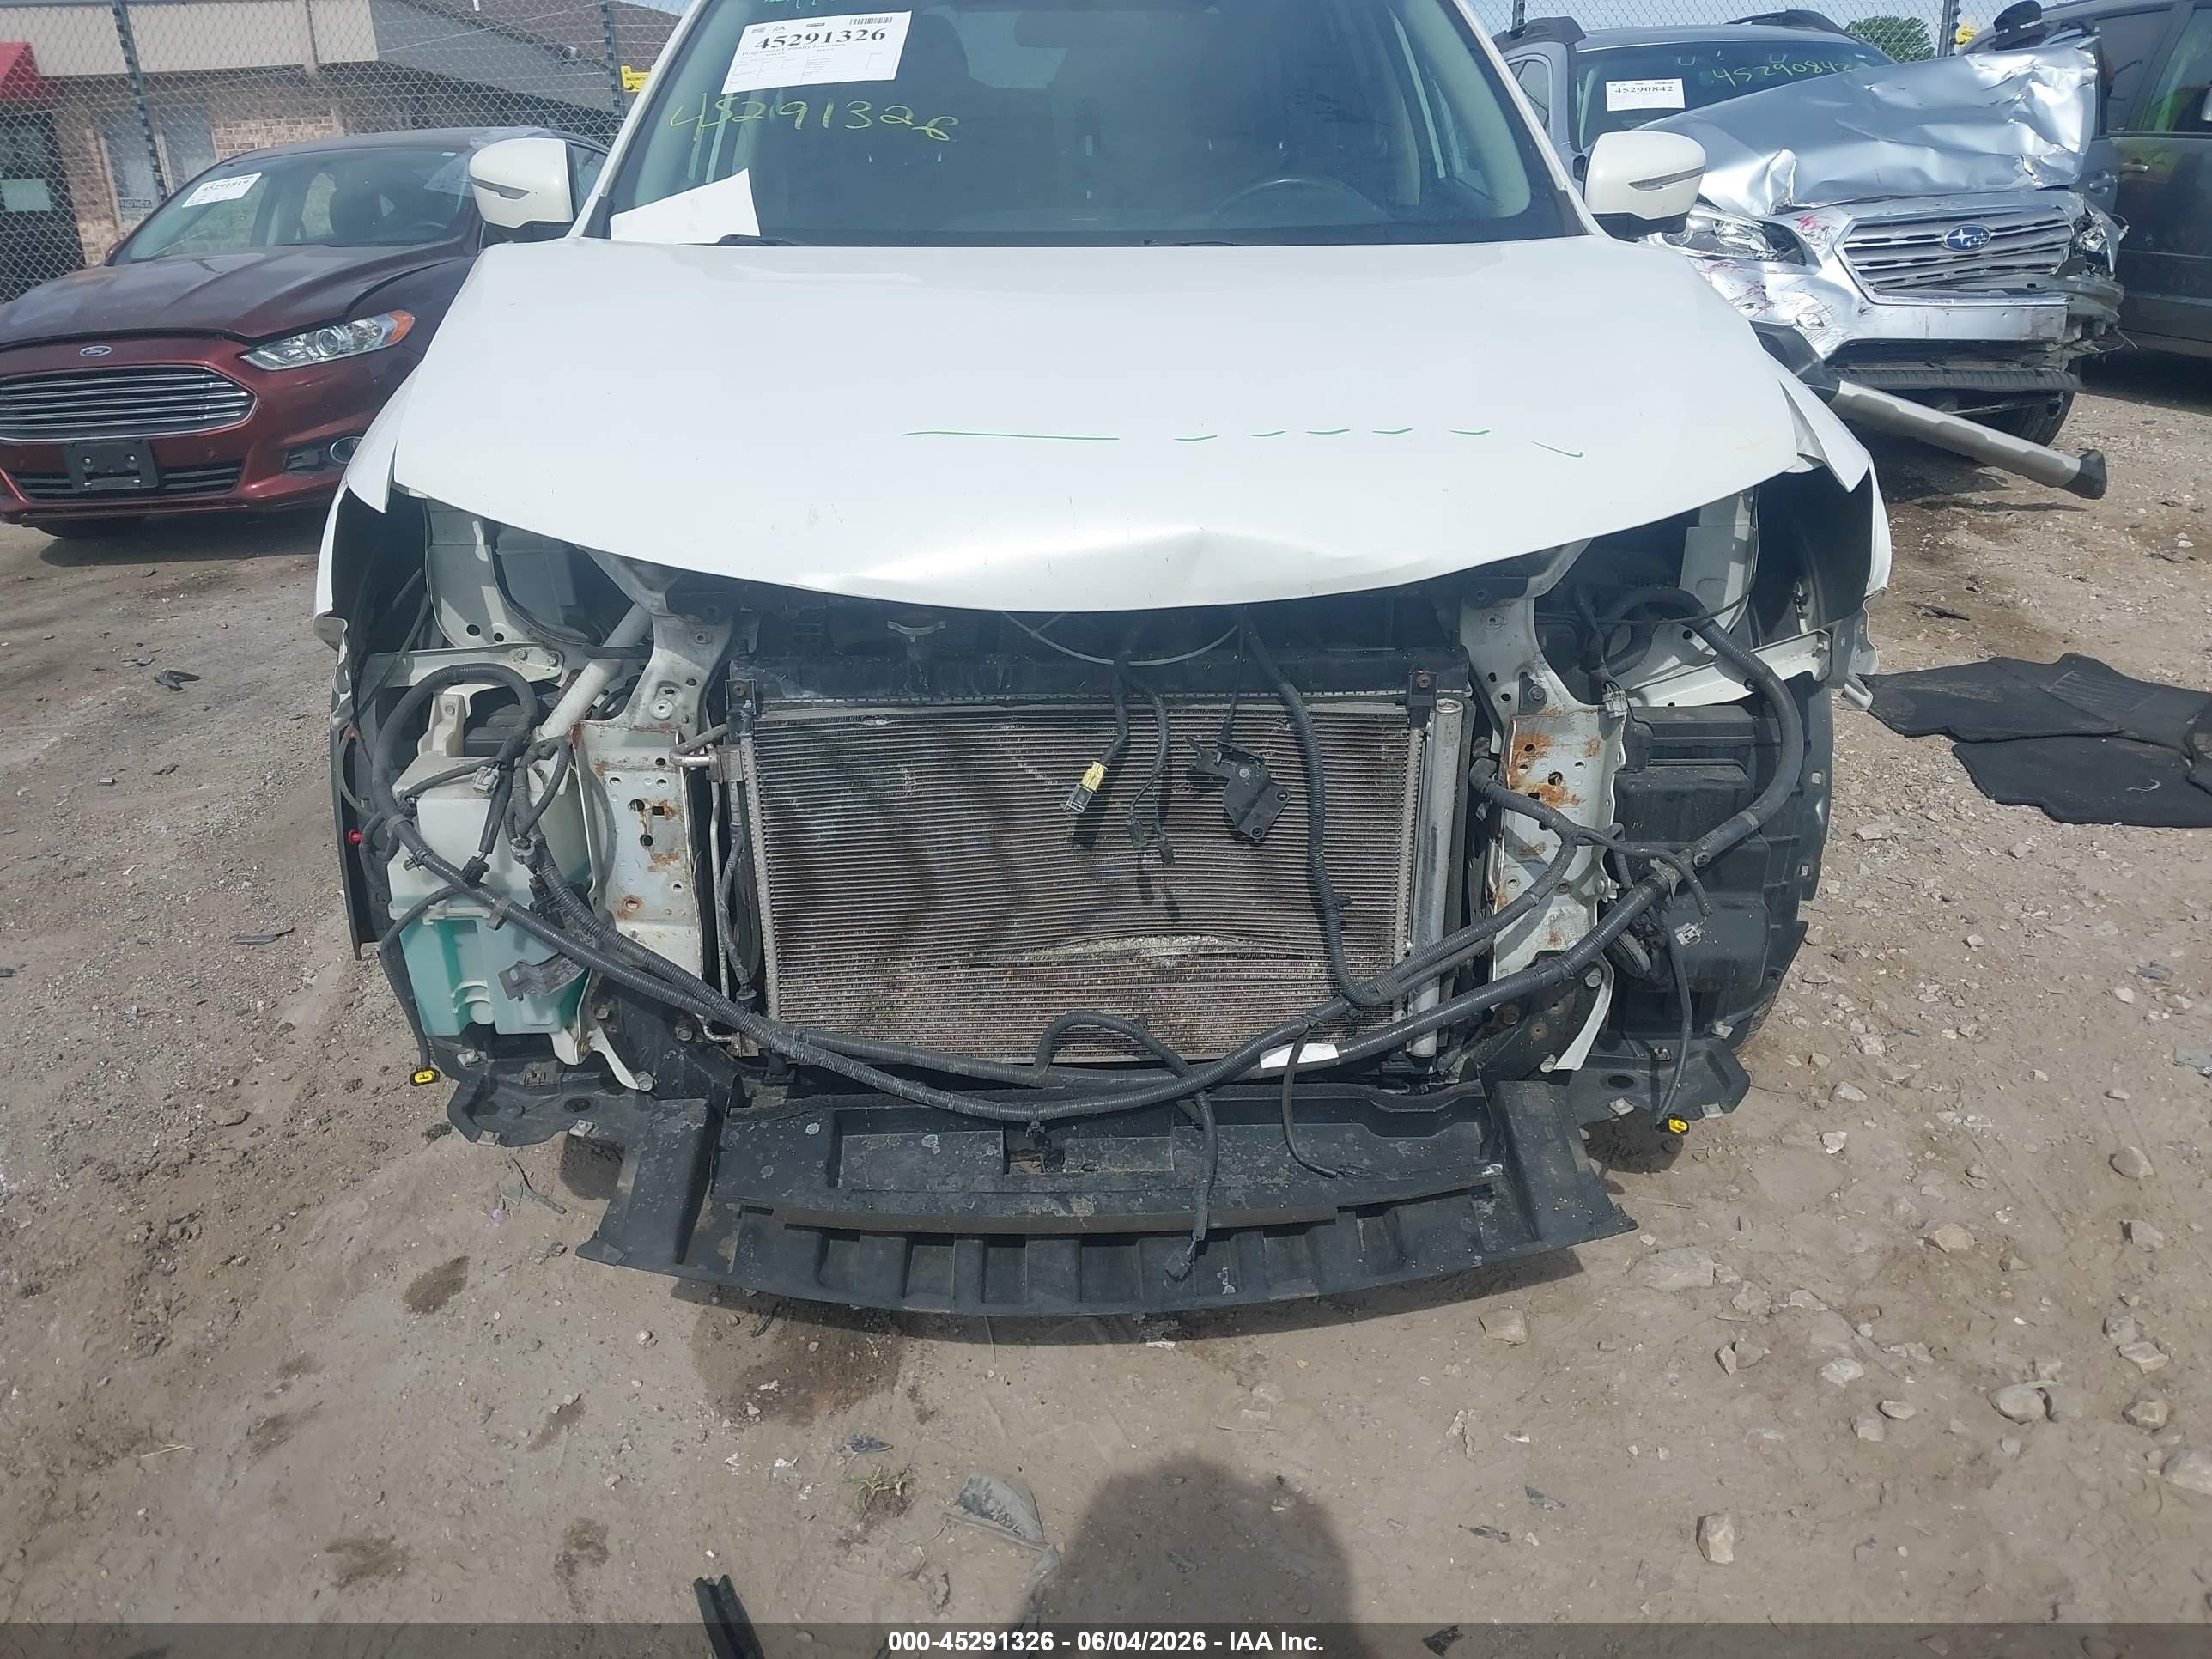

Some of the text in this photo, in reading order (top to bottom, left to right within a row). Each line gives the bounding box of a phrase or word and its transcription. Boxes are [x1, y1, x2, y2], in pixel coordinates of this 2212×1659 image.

[755, 28, 886, 49] 45291326
[1614, 85, 1674, 94] 45290842
[670, 93, 959, 142] 45291326
